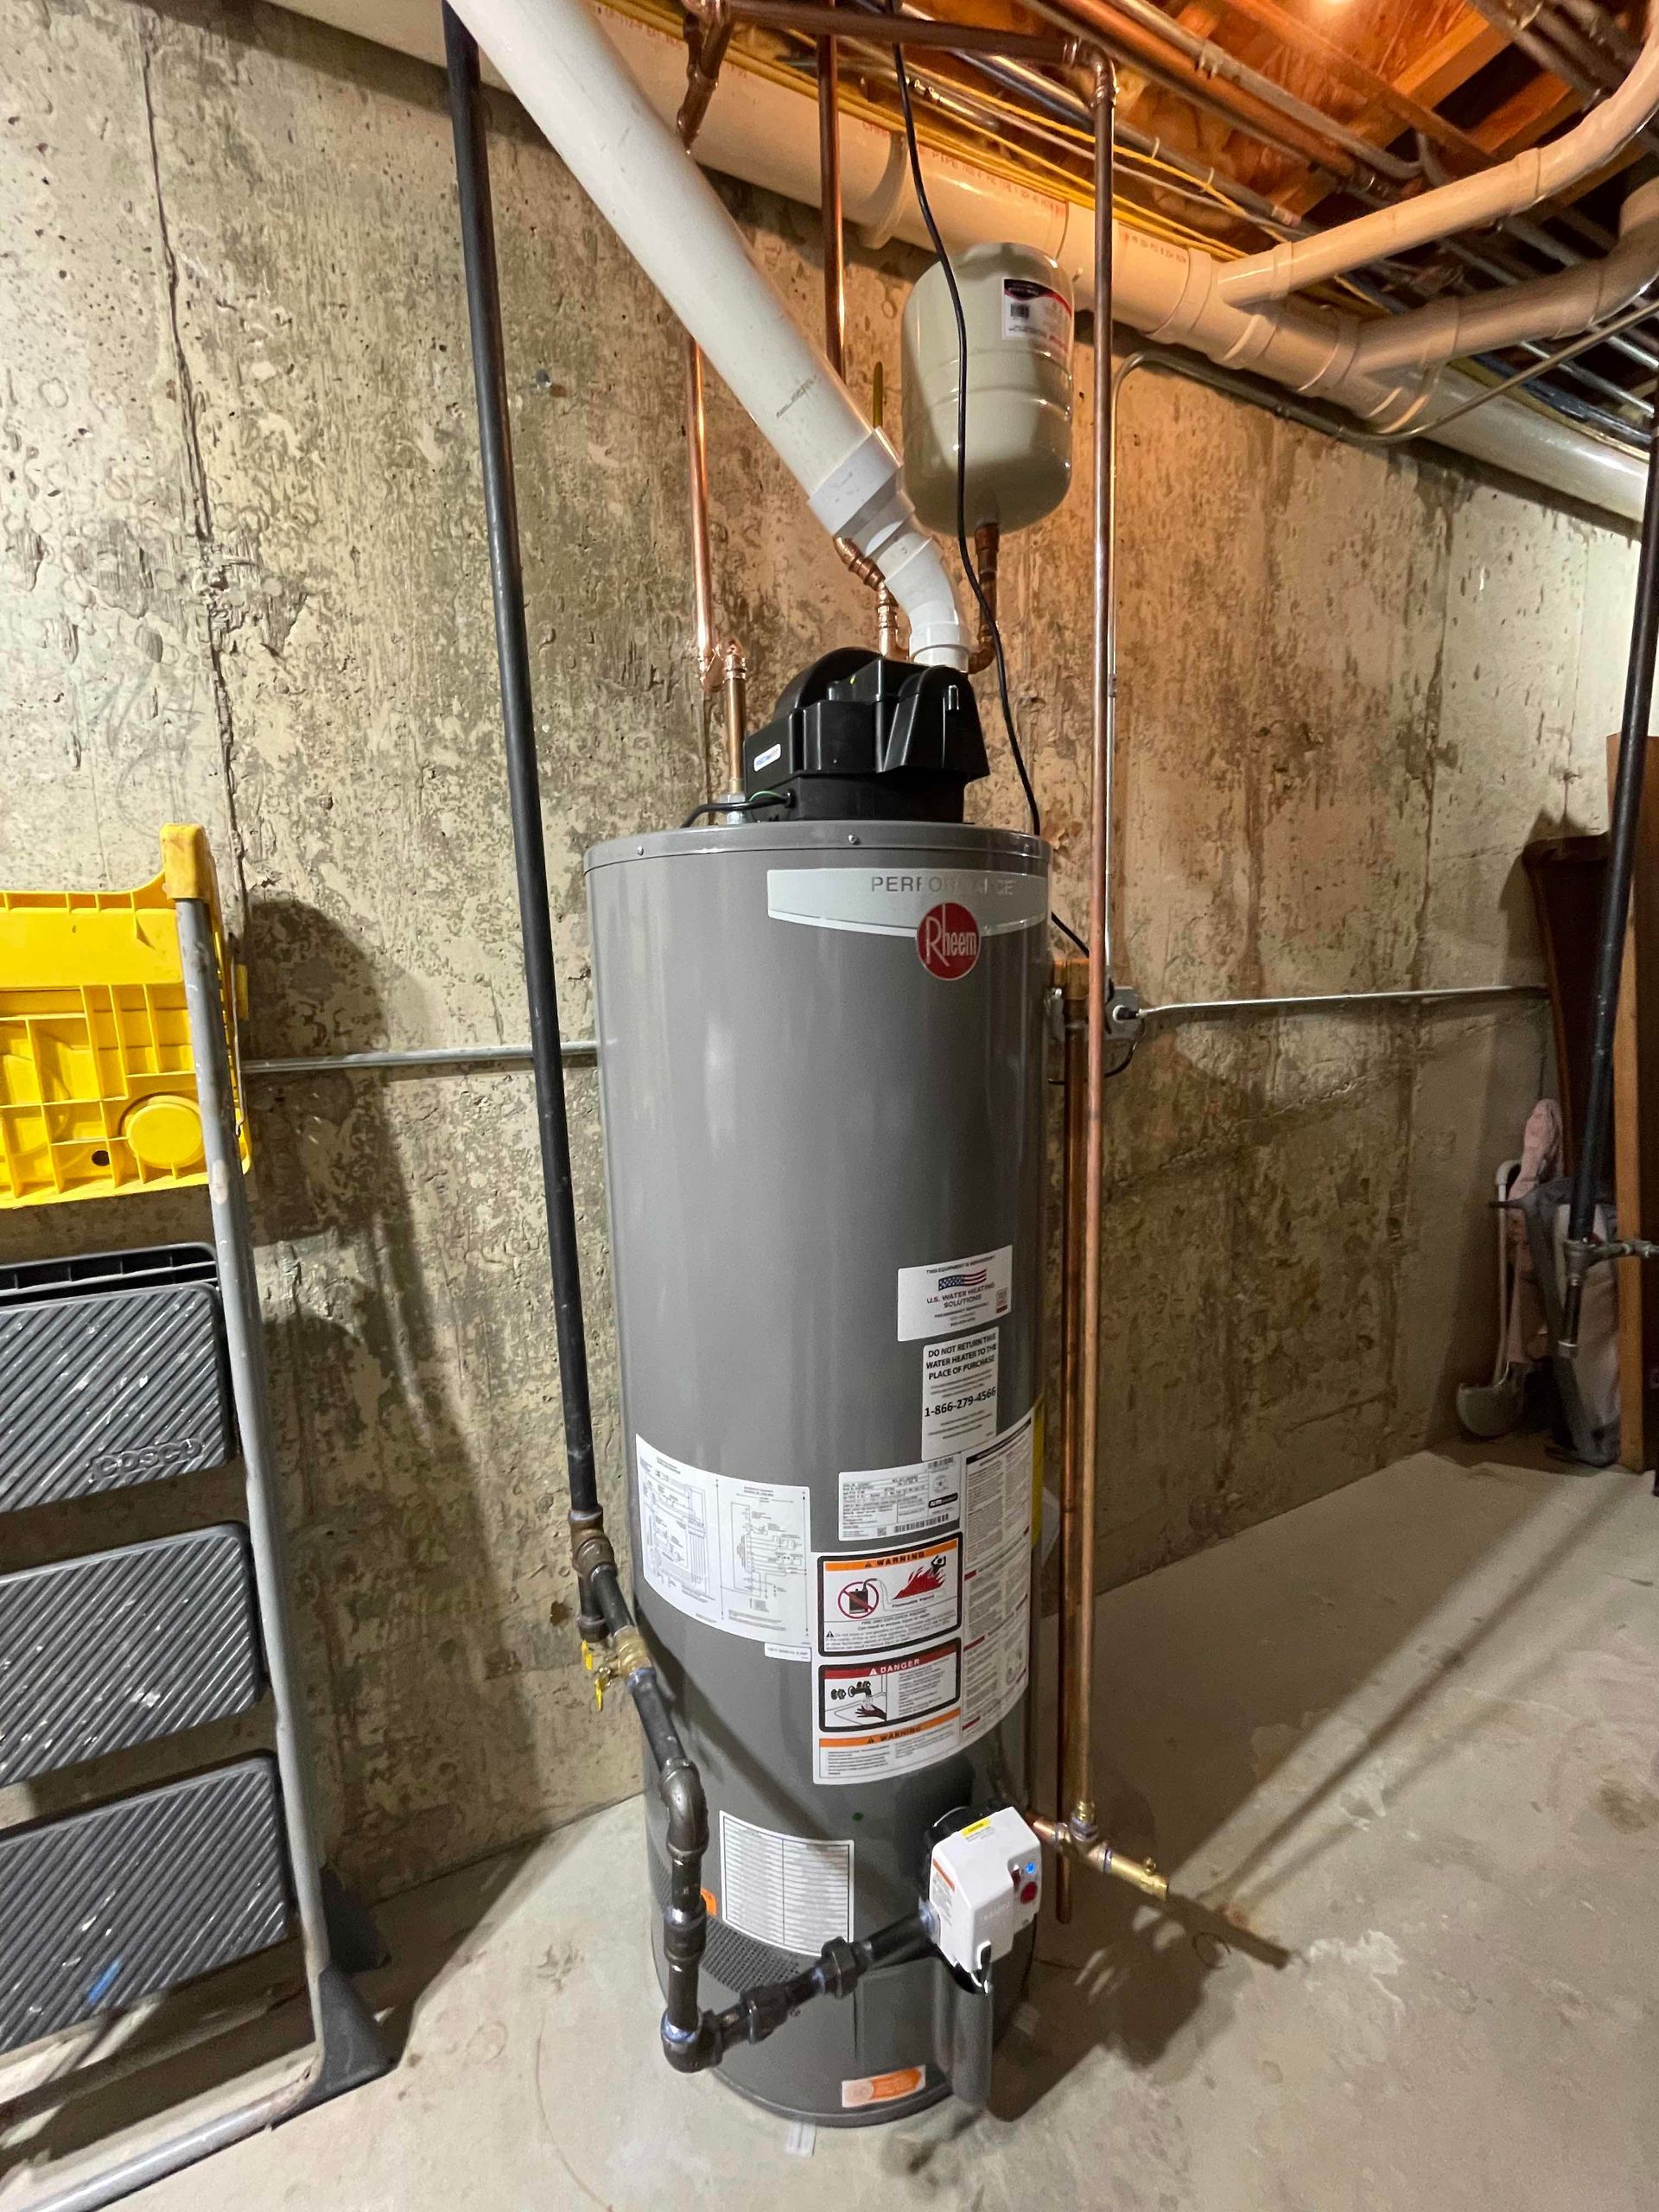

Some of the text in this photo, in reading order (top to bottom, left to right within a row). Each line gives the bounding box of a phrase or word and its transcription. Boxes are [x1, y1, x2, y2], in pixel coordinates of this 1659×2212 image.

[871, 876, 1016, 895] PERFONCE
[925, 903, 977, 967] Rheem
[942, 1289, 966, 1300] WATER
[968, 1282, 995, 1294] HEATING
[944, 1294, 982, 1308] SOLUTIONS
[941, 1345, 957, 1355] NOT
[957, 1338, 982, 1351] RETURN
[982, 1333, 995, 1344] THIS
[926, 1358, 950, 1370] WATER
[951, 1351, 976, 1363] HEATER
[987, 1343, 996, 1352] THE
[929, 1355, 995, 1380] PLACE OF PURCHASE
[925, 1387, 996, 1417] 1-866-279-4566
[877, 1552, 925, 1566] WARNING
[880, 1658, 920, 1673] DANGER
[880, 1726, 921, 1740] WARNING
